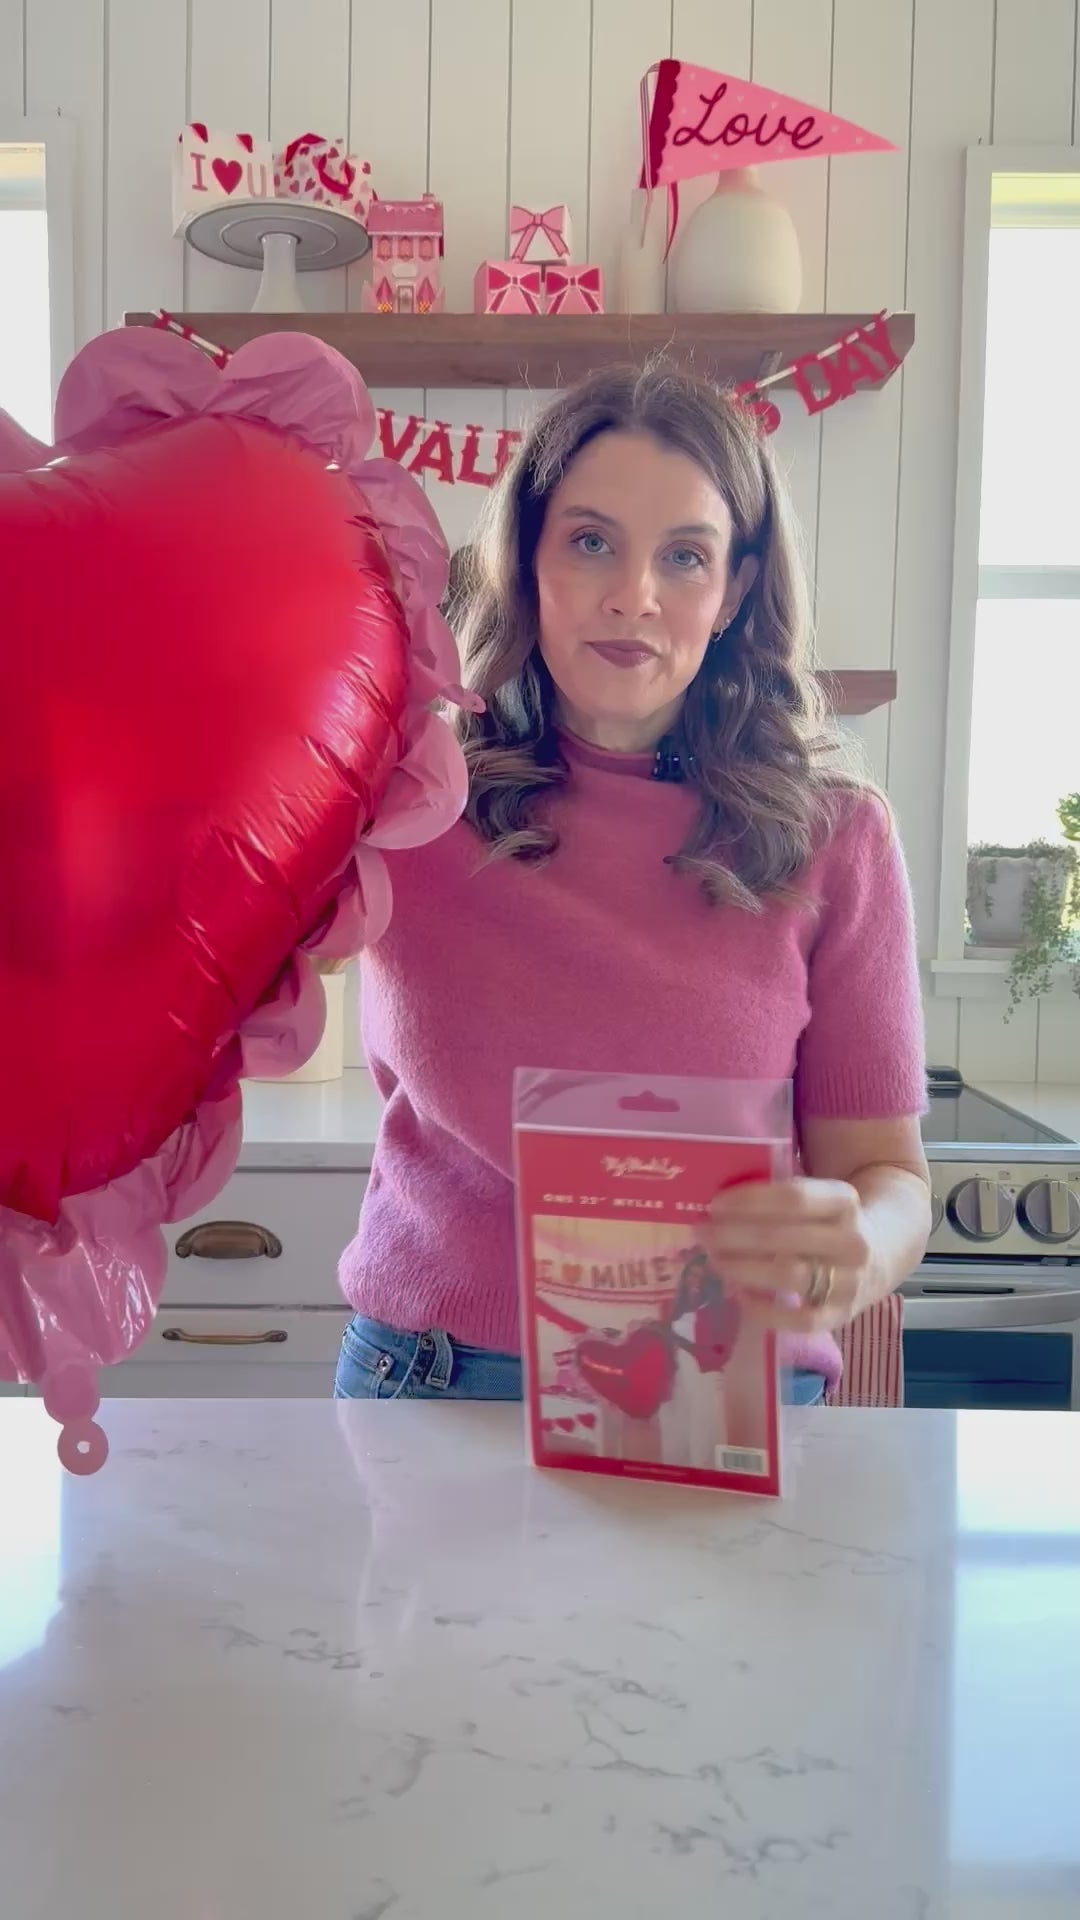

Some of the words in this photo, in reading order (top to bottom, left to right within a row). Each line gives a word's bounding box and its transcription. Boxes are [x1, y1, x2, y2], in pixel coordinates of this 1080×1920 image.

[672, 82, 824, 151] Love
[189, 151, 209, 192] I
[246, 161, 268, 199] U
[787, 308, 904, 417] DAY
